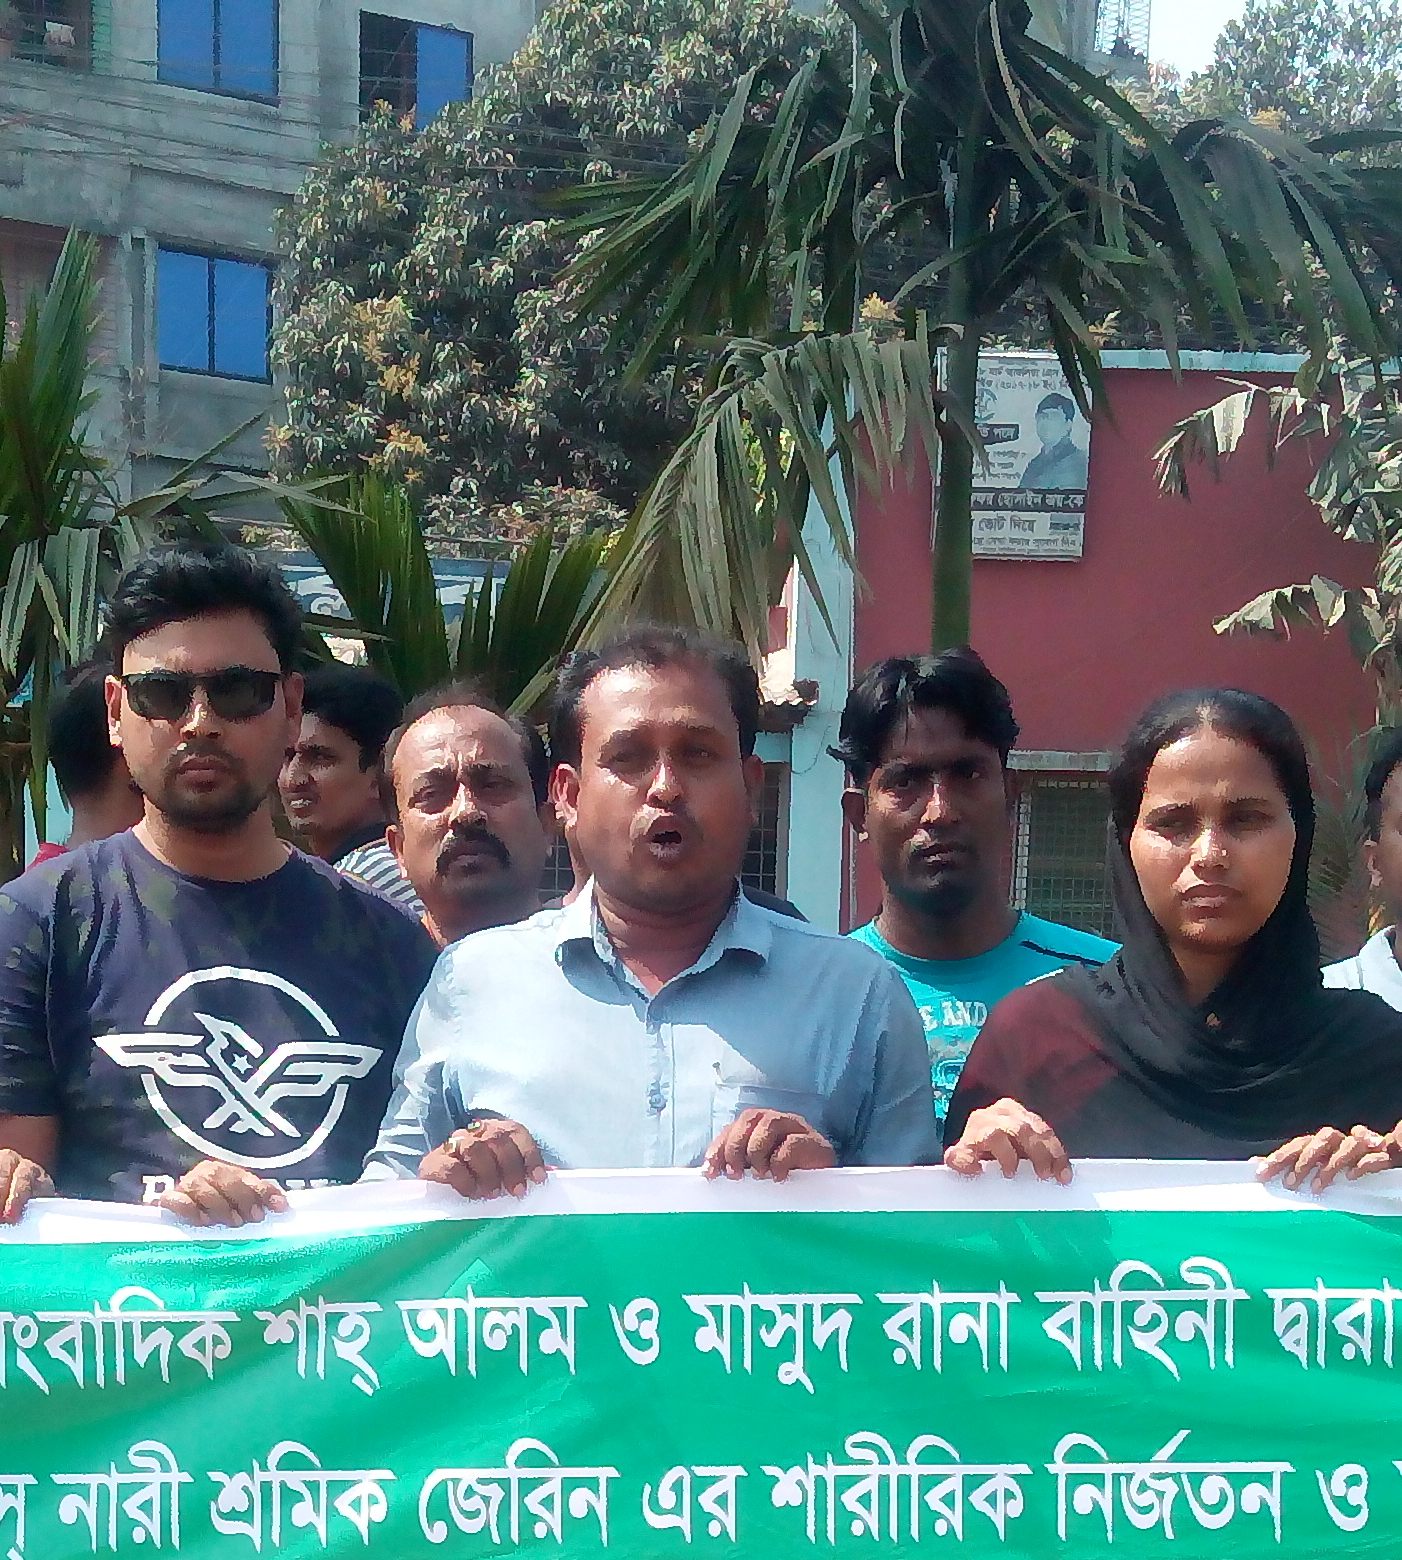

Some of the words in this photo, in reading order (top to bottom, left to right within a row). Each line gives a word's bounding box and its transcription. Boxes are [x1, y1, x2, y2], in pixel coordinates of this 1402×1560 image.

[253, 1295, 384, 1396] শাহ্
[395, 1284, 588, 1378] আলম
[609, 1297, 660, 1366] ও
[682, 1282, 864, 1394] মাসুদ
[876, 1280, 1022, 1374] রানা
[1034, 1256, 1251, 1381] বাহিনী
[51, 1440, 194, 1553] নারী
[209, 1440, 396, 1554] শ্রমিক
[418, 1437, 621, 1547] জেরিন
[642, 1463, 748, 1544] এর
[762, 1430, 1034, 1546] শারীরিক
[1046, 1429, 1295, 1544] নির্জতন
[1315, 1463, 1370, 1533] ও
